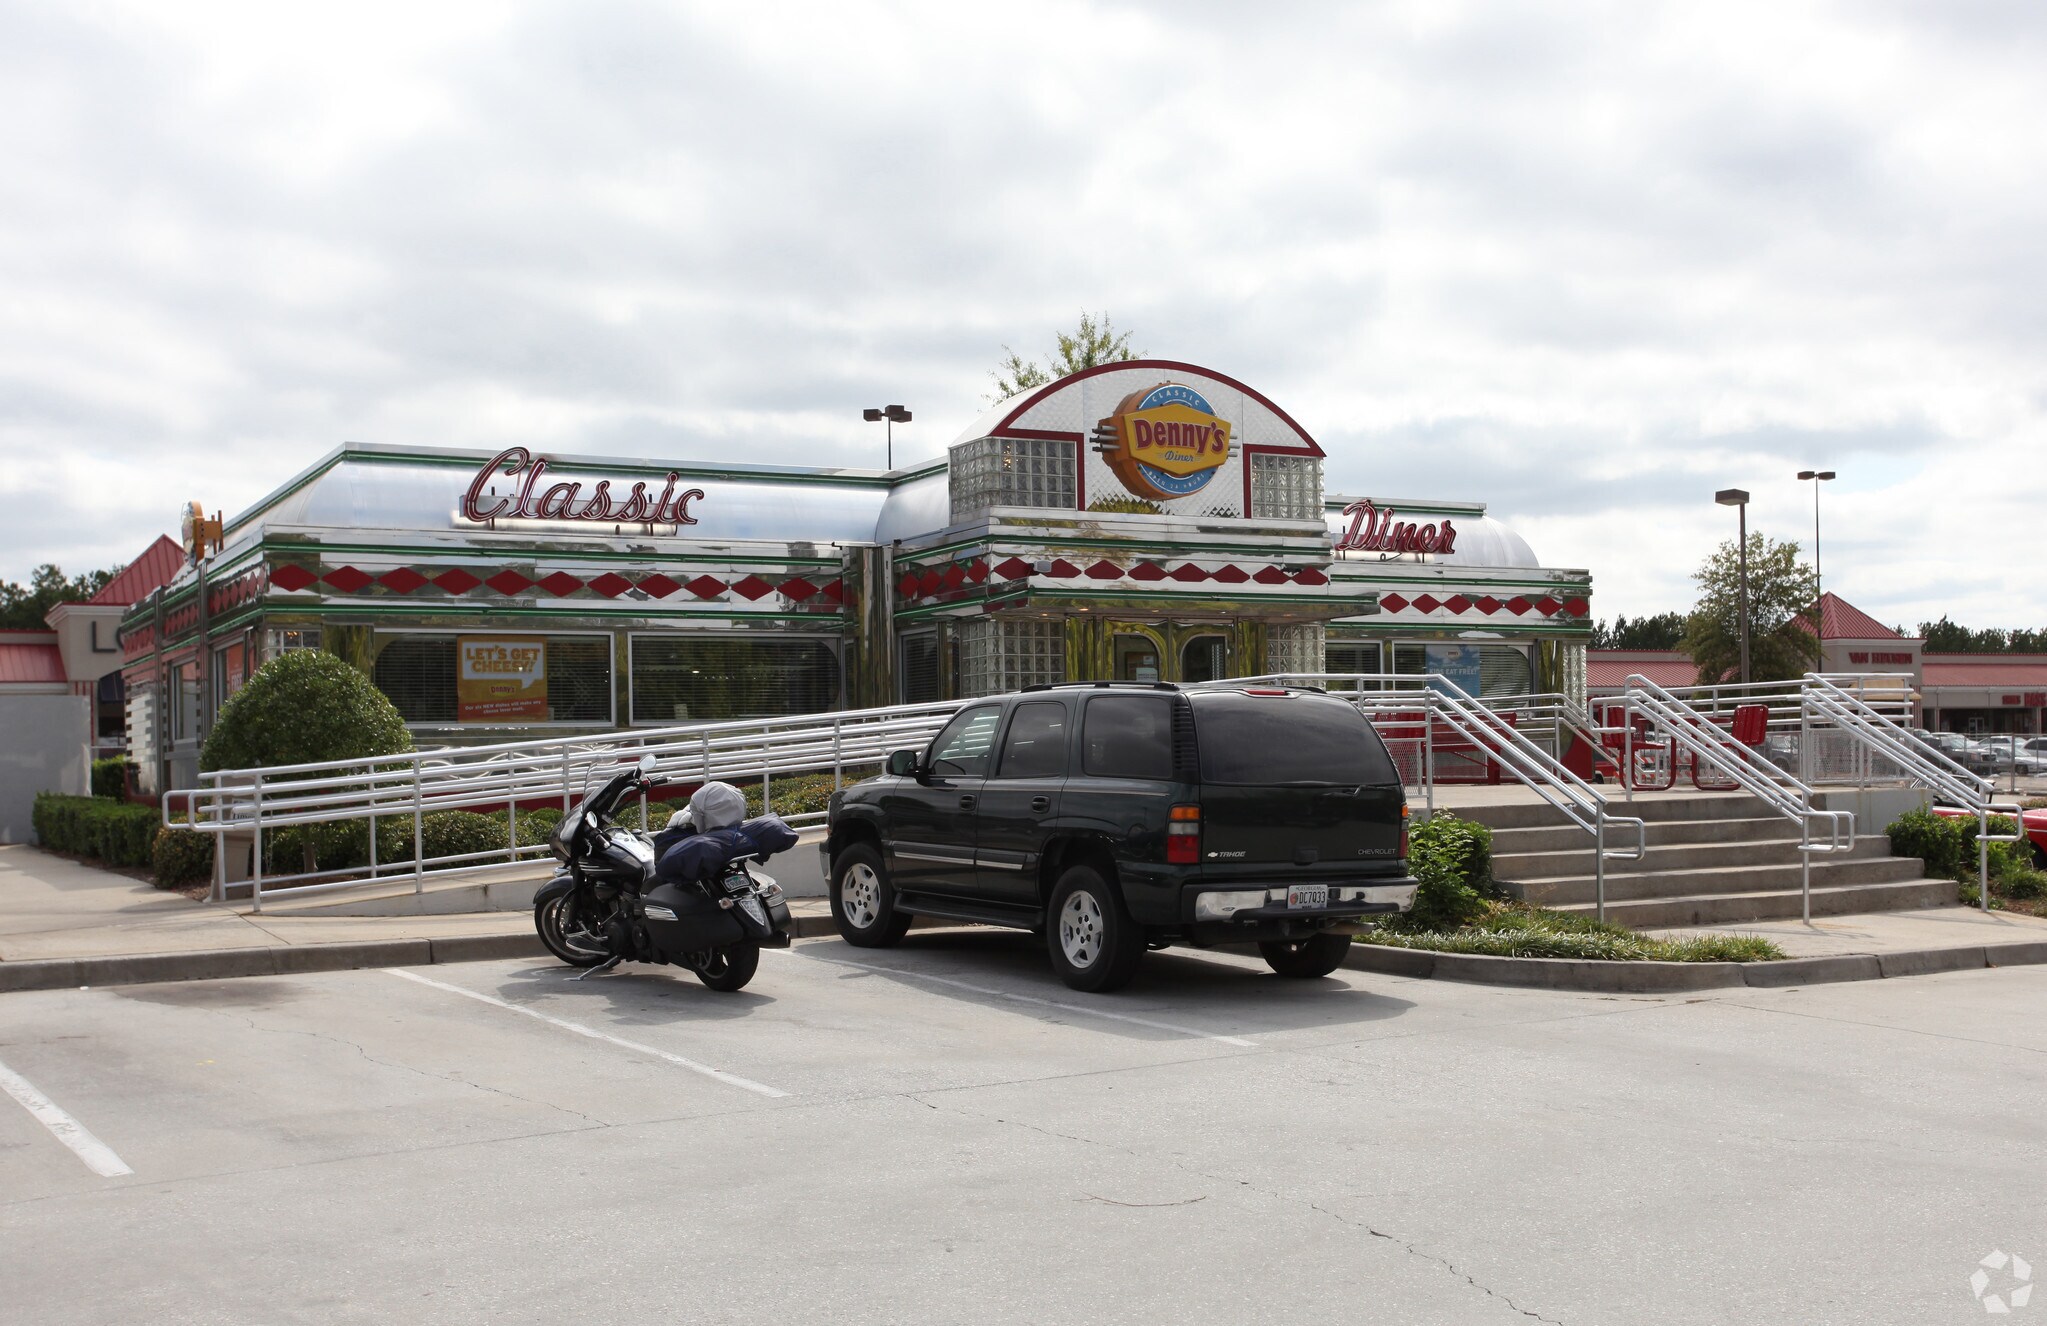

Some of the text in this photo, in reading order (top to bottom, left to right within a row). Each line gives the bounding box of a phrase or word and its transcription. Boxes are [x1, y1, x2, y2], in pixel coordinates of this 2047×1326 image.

[1151, 389, 1200, 406] CLASSIC
[1133, 417, 1226, 455] Denny's
[1164, 450, 1194, 463] Diner
[464, 446, 705, 525] Classic
[1335, 499, 1457, 554] Diner
[465, 645, 540, 660] LET'S GET
[471, 660, 535, 673] CHEESY!
